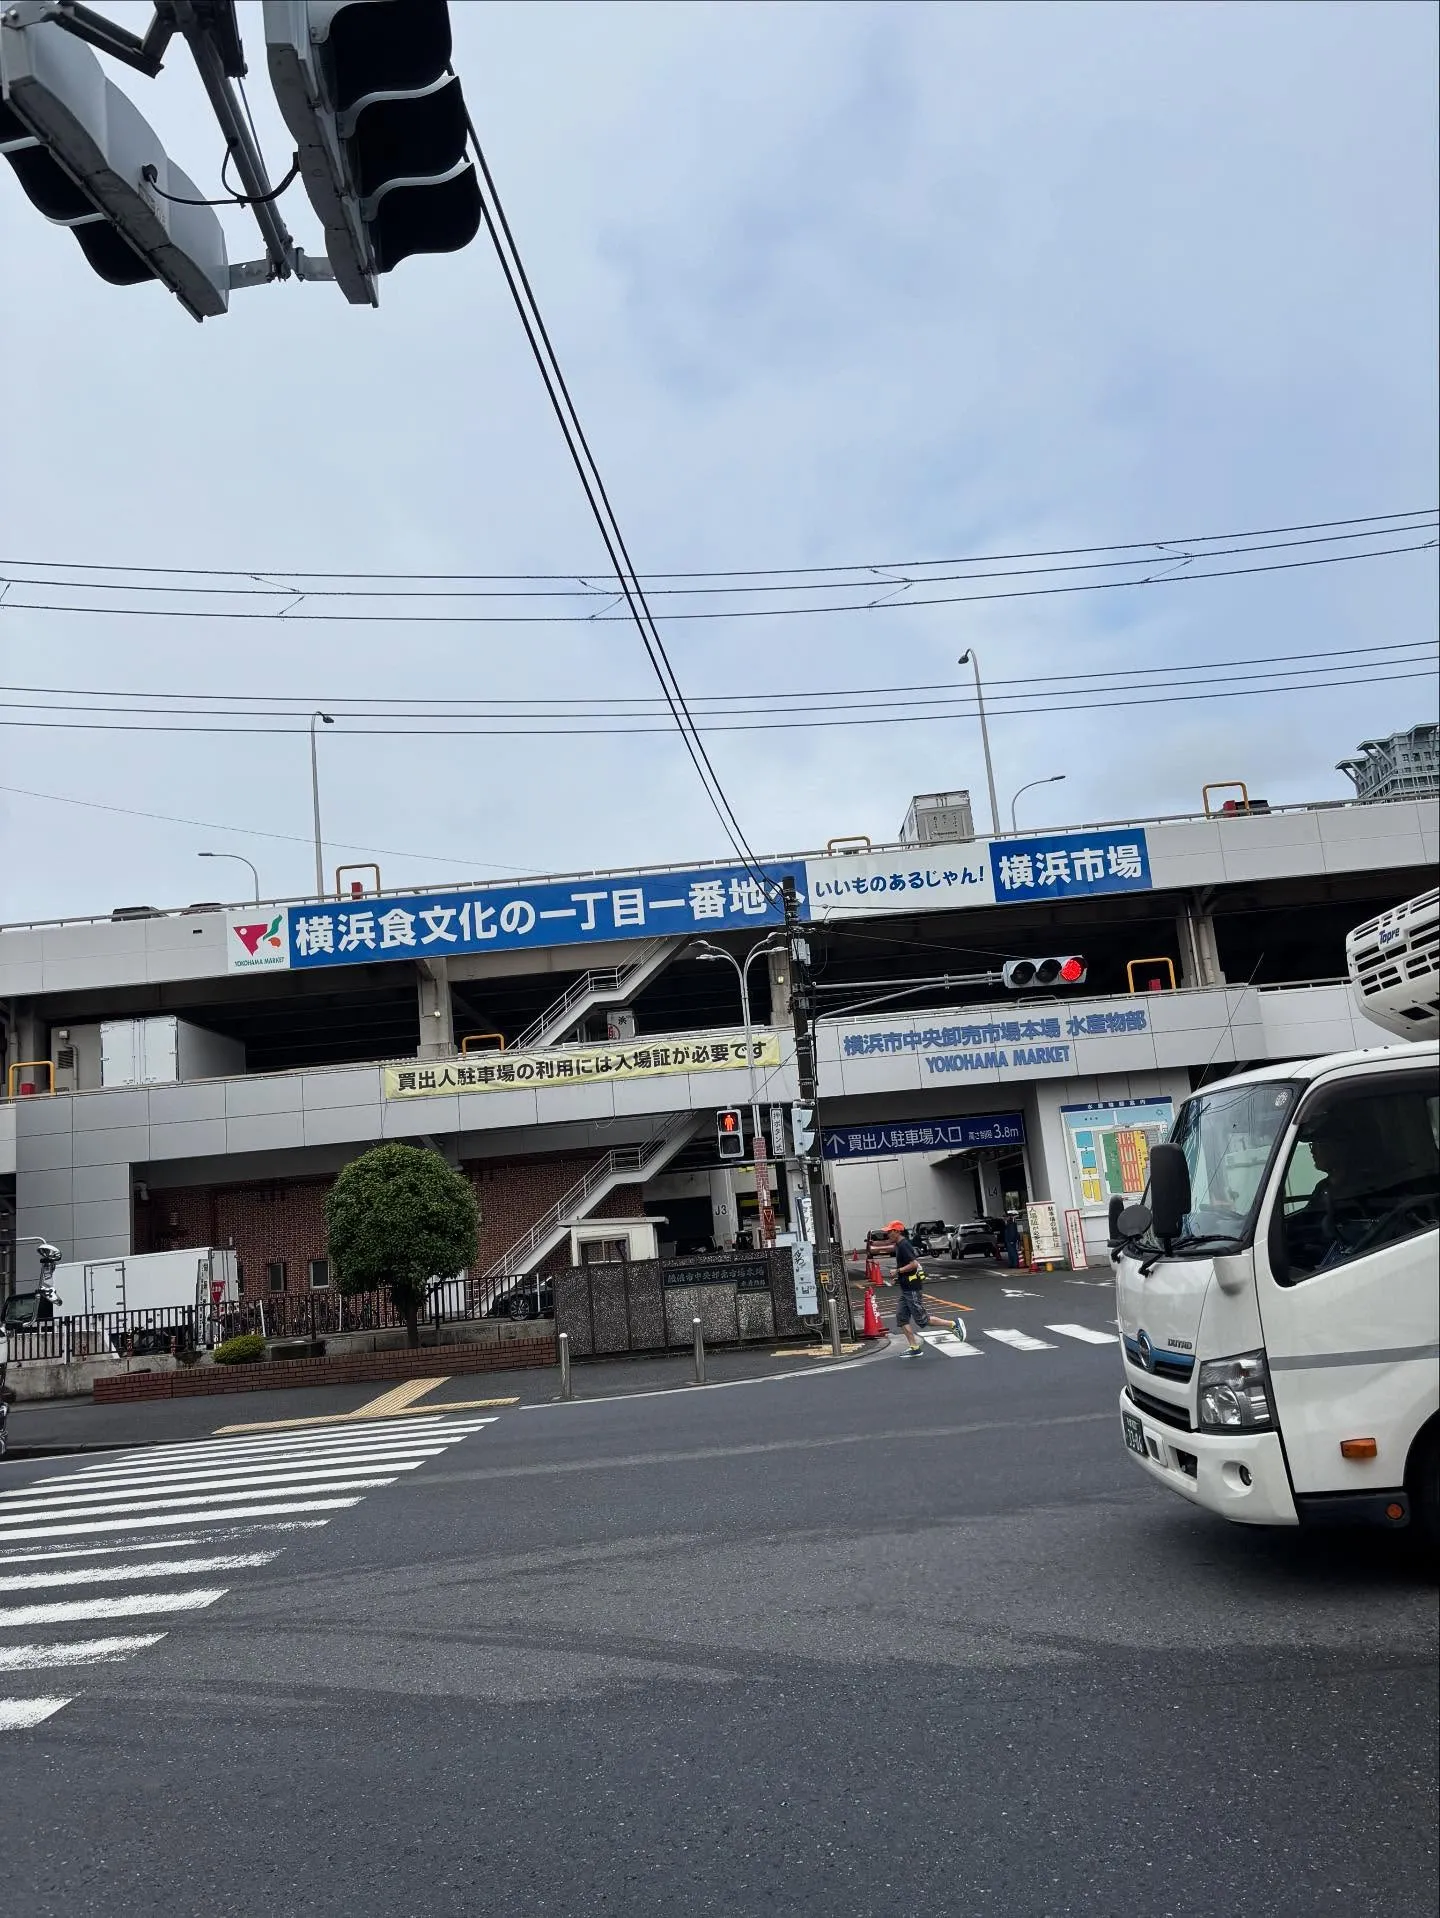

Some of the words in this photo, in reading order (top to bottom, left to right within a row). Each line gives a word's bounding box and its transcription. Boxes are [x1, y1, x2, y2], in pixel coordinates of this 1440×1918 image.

[815, 866, 985, 898] いいものあるじゃん!
[999, 844, 1143, 891] 横浜市場
[1379, 927, 1400, 945] Topre
[234, 958, 263, 968] YOKOHAMA
[264, 956, 285, 966] MARKET
[843, 1017, 1061, 1057] 横浜市中央卸売市場本場
[1066, 1009, 1147, 1038] 水産物部
[397, 1040, 767, 1091] 買出人駐車場の利用には入場証が必要です
[925, 1049, 1009, 1074] YOKOHAMA
[1013, 1044, 1070, 1068] MARKET
[847, 1126, 962, 1152] 買出人駐車場入口
[993, 1123, 1019, 1139] 3.8m
[715, 1204, 727, 1216] J3
